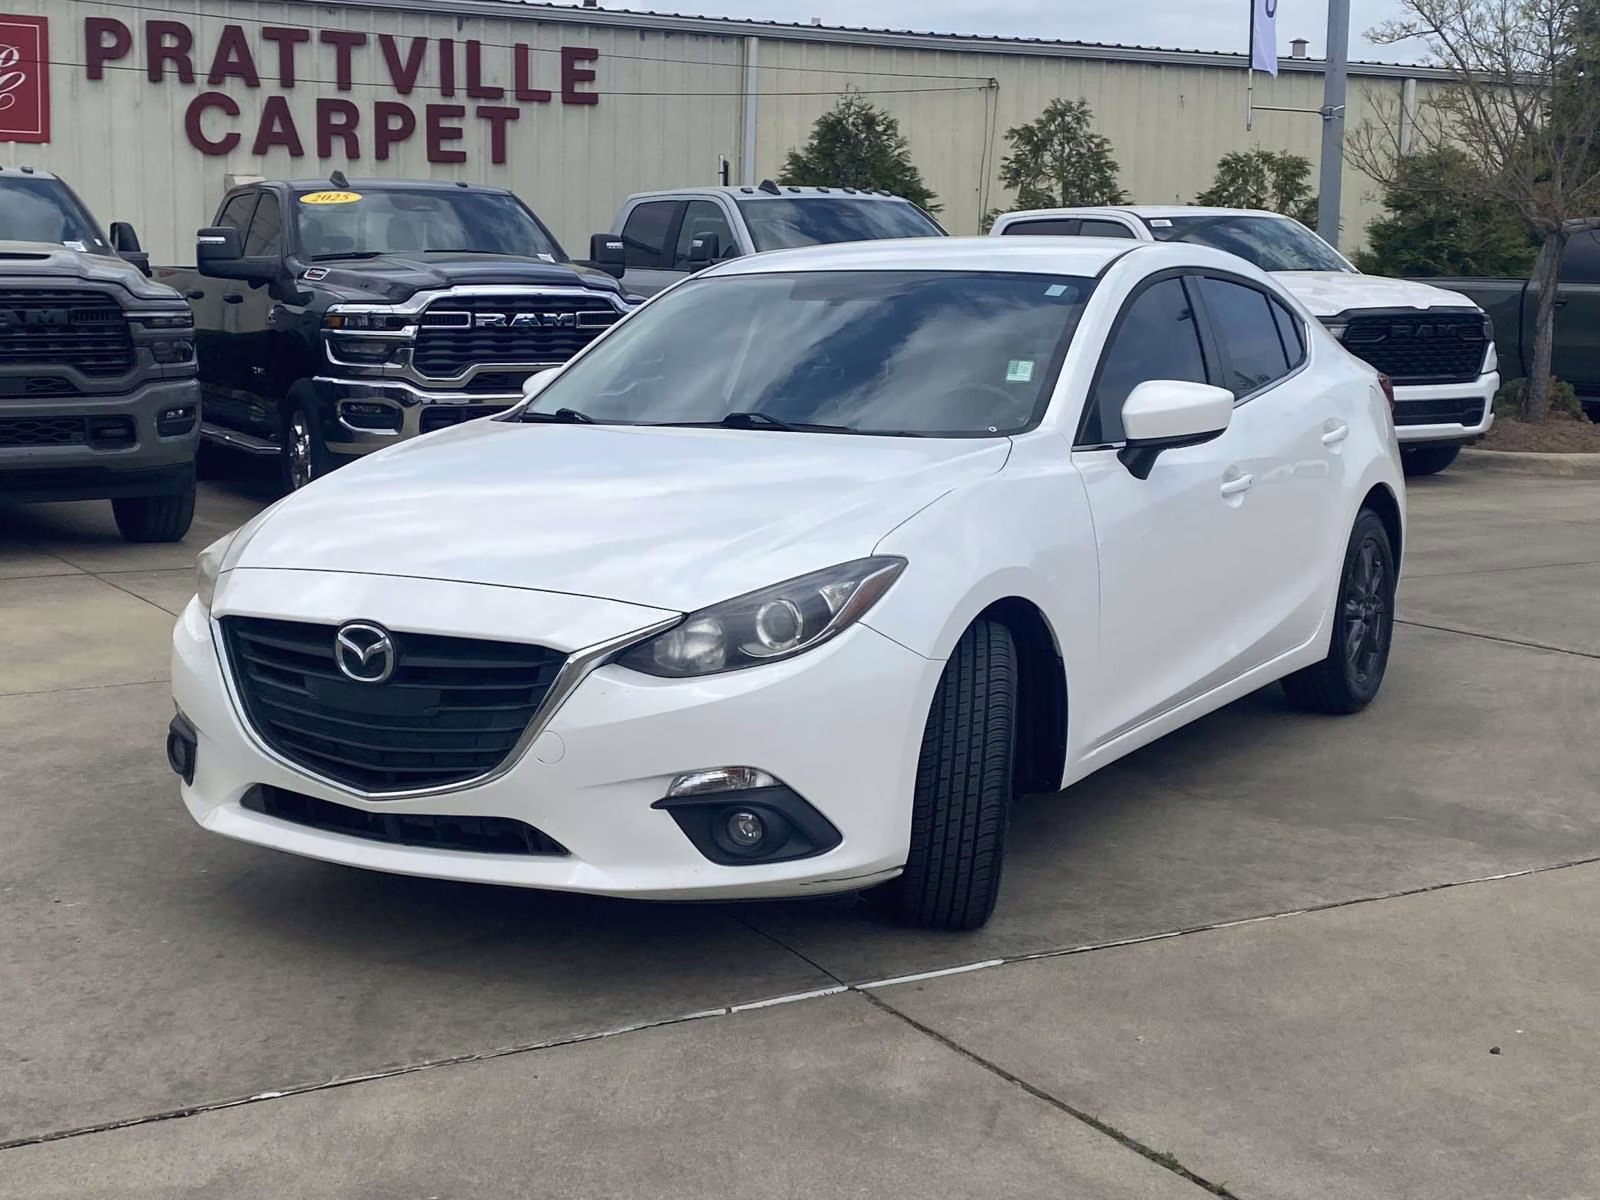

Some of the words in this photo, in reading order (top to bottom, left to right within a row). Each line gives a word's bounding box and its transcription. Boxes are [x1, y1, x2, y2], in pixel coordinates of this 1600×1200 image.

[84, 16, 600, 106] PRATTVILLE
[184, 90, 521, 165] CARPET
[311, 193, 351, 202] 2025
[0, 308, 68, 325] AM
[474, 312, 575, 328] RAM
[1390, 324, 1458, 338] RAM
